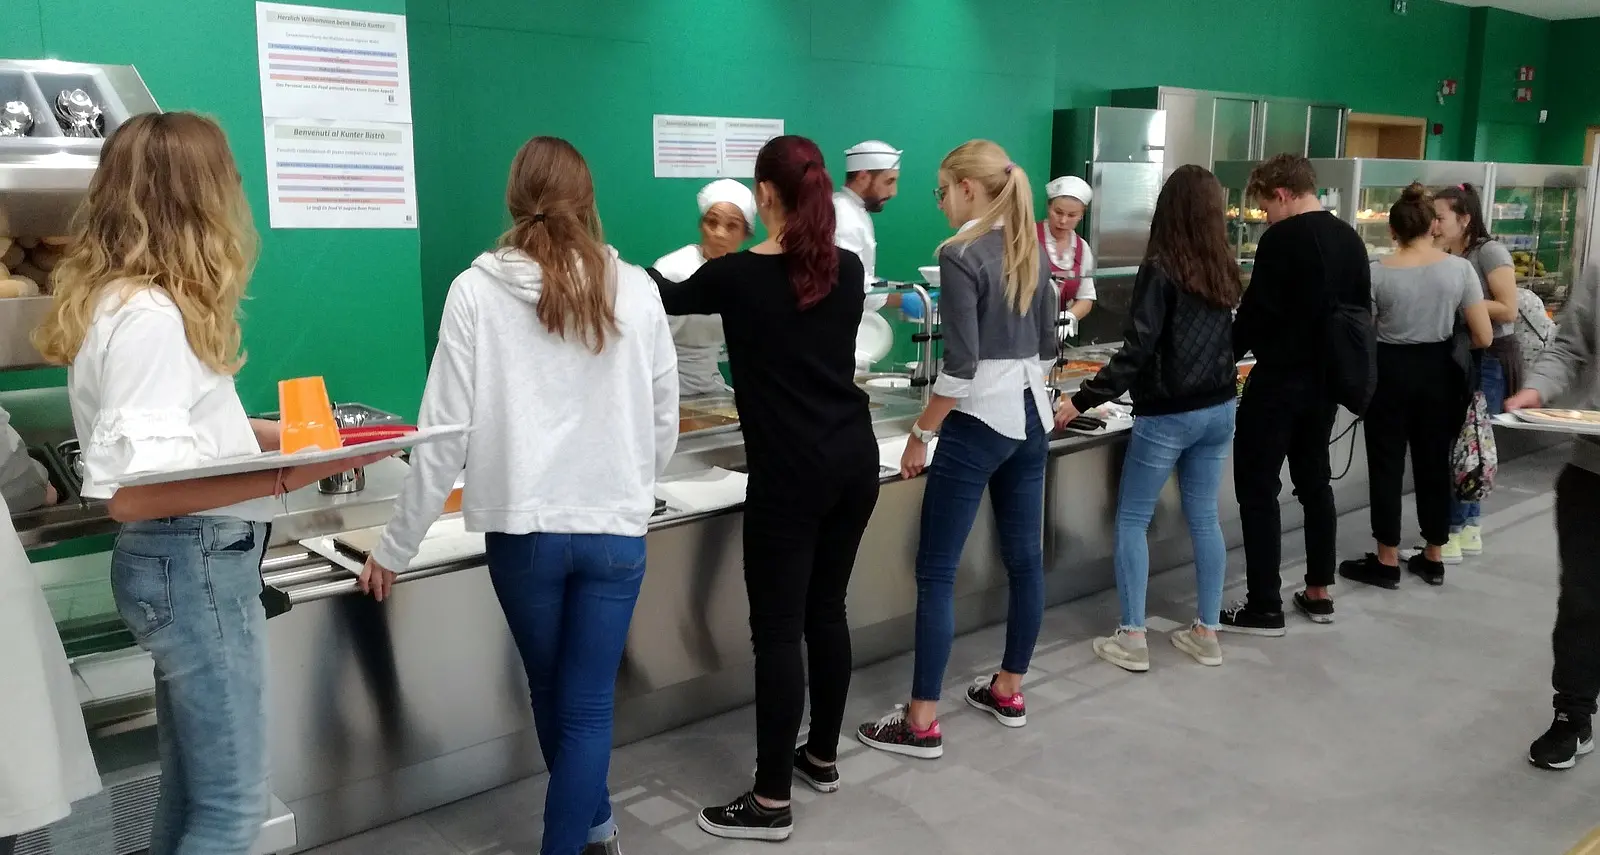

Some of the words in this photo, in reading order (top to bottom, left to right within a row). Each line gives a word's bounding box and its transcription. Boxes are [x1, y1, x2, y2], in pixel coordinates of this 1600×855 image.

[277, 13, 301, 22] Herzlich
[302, 16, 336, 25] Willkommen
[336, 19, 350, 27] beim
[293, 128, 331, 138] Benvenuti
[331, 129, 339, 138] al
[340, 130, 364, 139] Kunter
[365, 131, 385, 140] Bistrò
